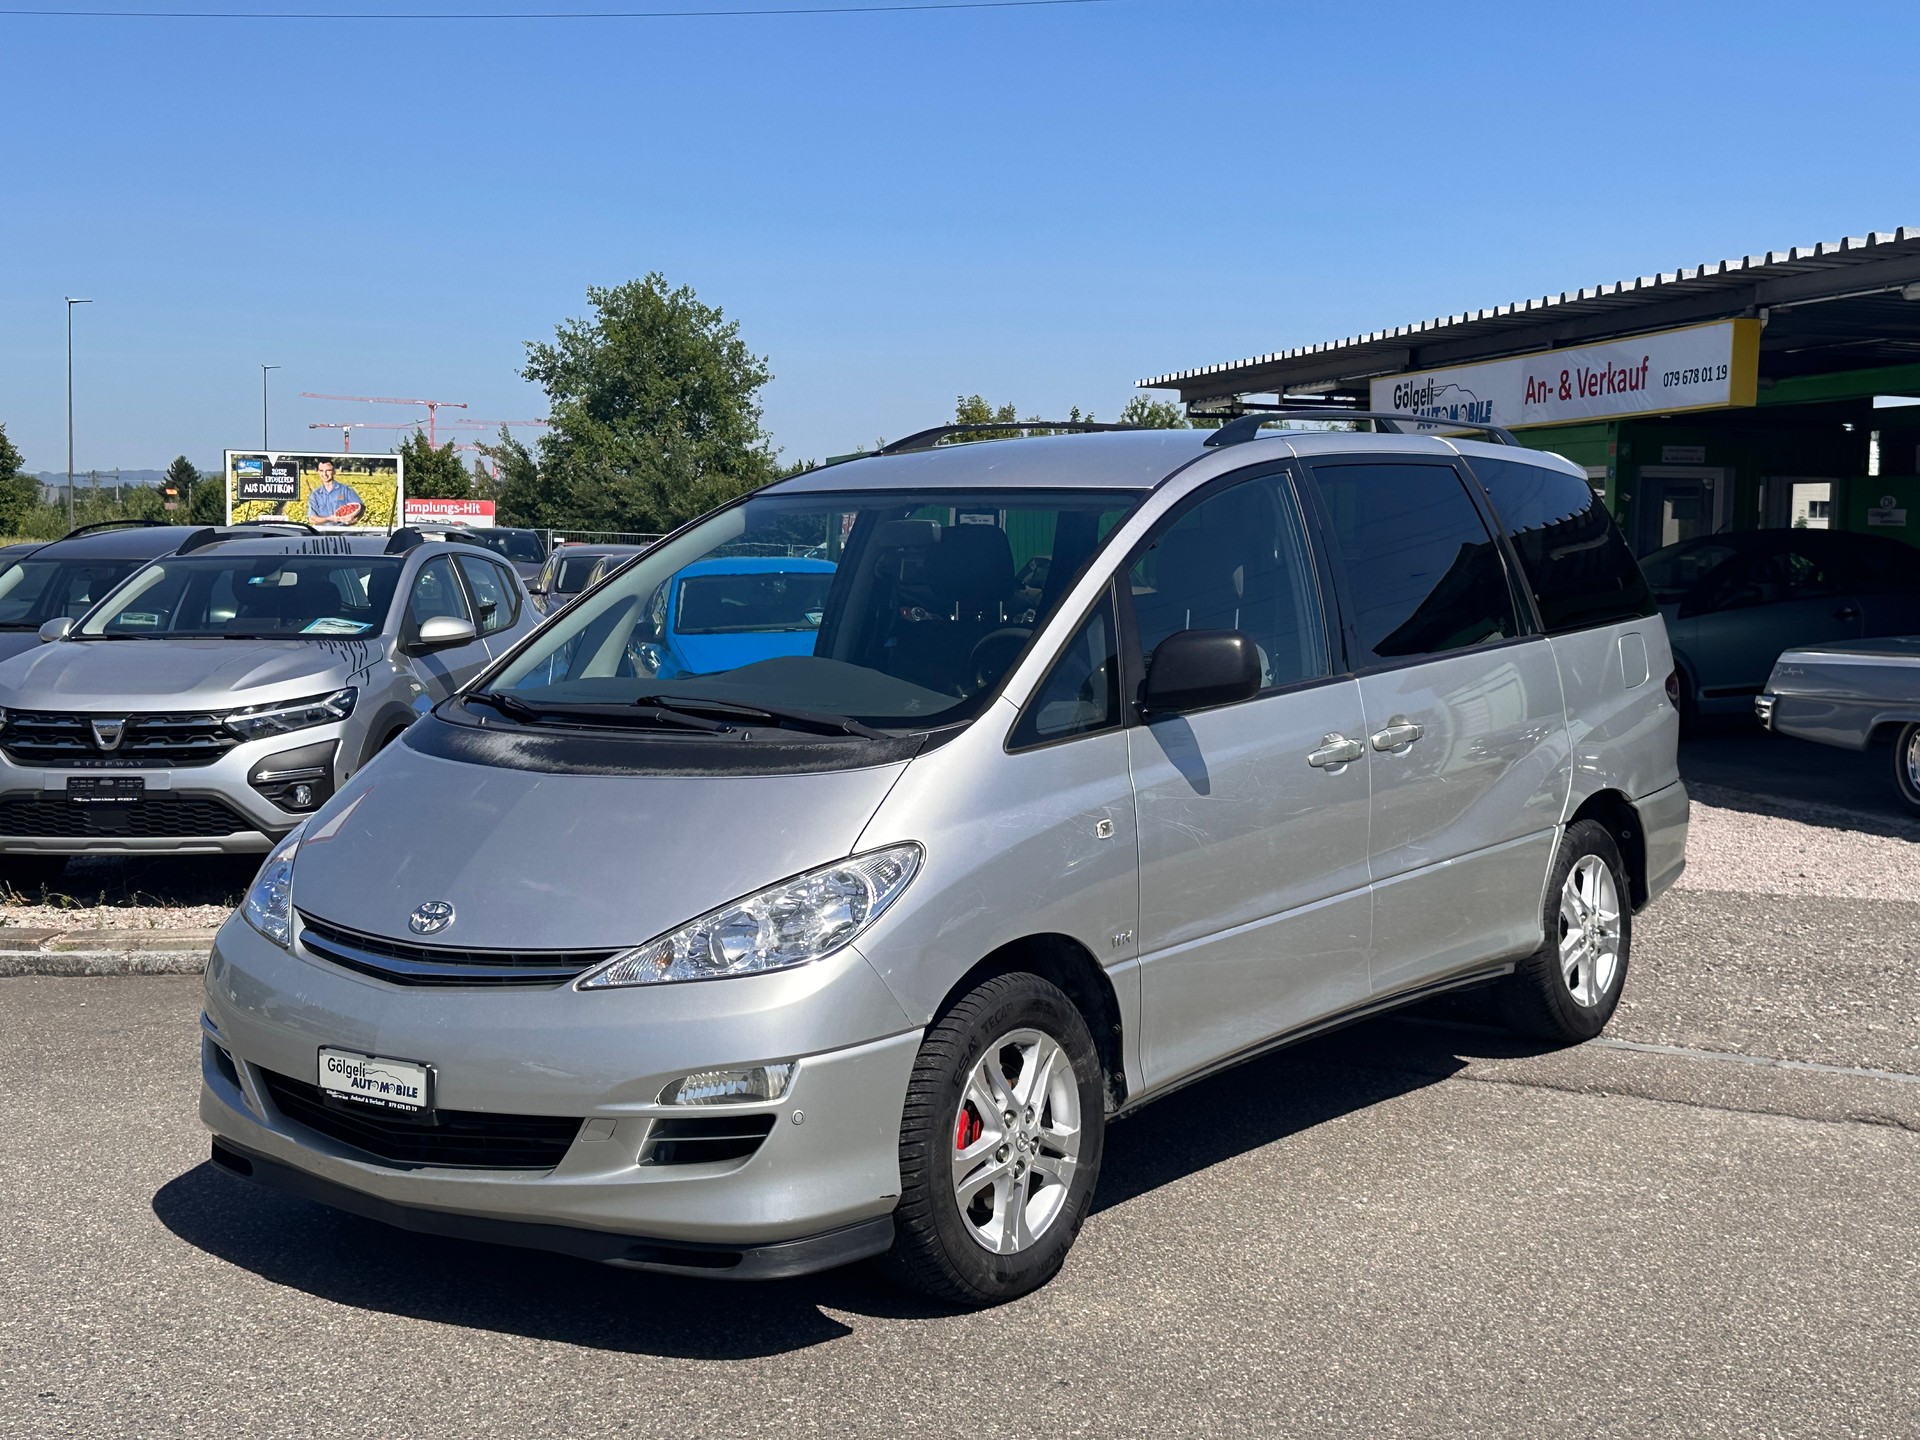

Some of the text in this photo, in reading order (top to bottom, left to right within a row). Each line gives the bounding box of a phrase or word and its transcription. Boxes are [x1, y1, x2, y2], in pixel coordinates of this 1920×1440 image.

[1524, 355, 1649, 405] An- & Verkauf
[1663, 364, 1728, 387] 079 678 01 19
[1394, 378, 1434, 415] Gölgeli
[244, 483, 294, 494] AUS DOTTIKON
[327, 1057, 366, 1078] Gölgeli
